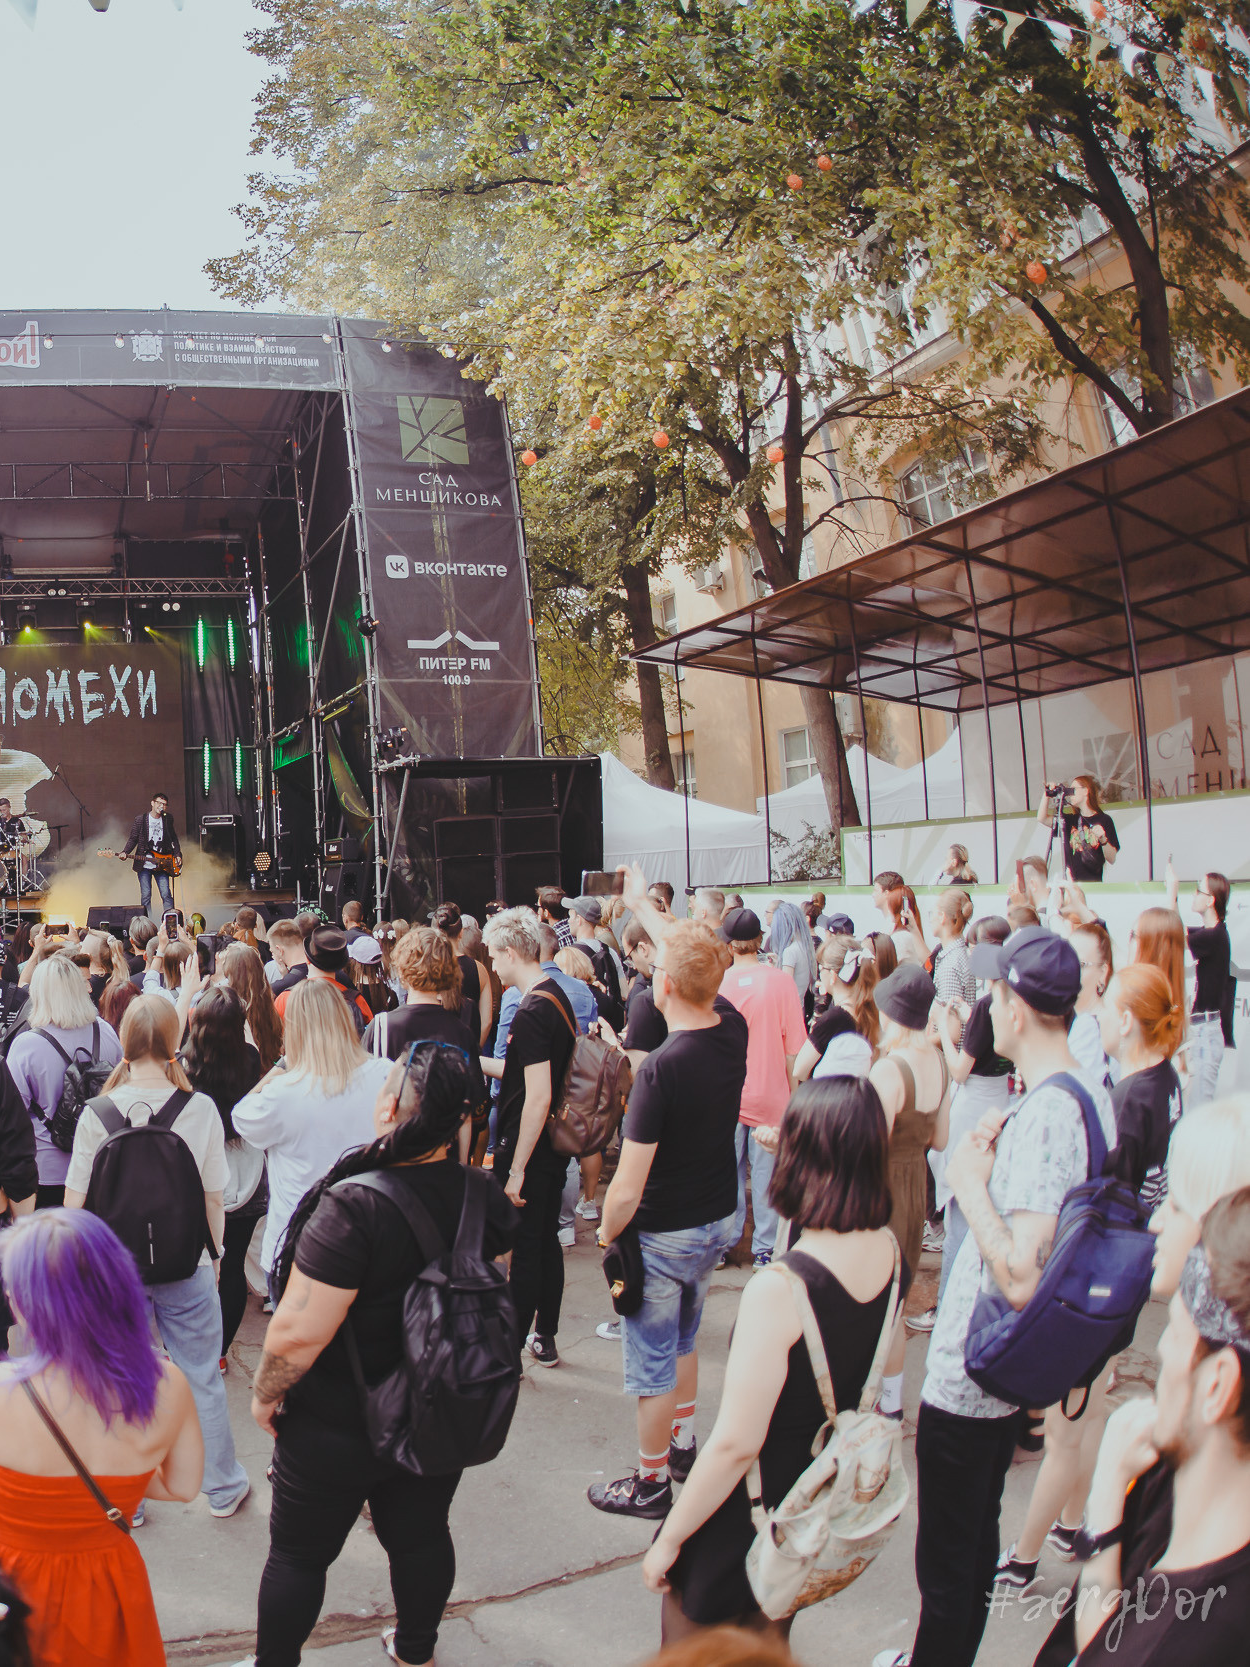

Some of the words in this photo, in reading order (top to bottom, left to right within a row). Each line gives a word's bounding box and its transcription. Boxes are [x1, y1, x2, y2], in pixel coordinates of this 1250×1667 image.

[216, 343, 222, 351] И
[174, 353, 180, 362] С
[182, 353, 252, 365] ОБЩЕСТВЕННЫМИ
[254, 356, 320, 367] ОРГАНИЗАЦИЯМИ
[418, 471, 459, 488] САД
[376, 488, 502, 507] МЕНШИКОВА
[419, 656, 467, 670] ПИТЕР
[471, 657, 491, 671] FM
[442, 674, 471, 686] 100.9
[1156, 724, 1222, 760] САД
